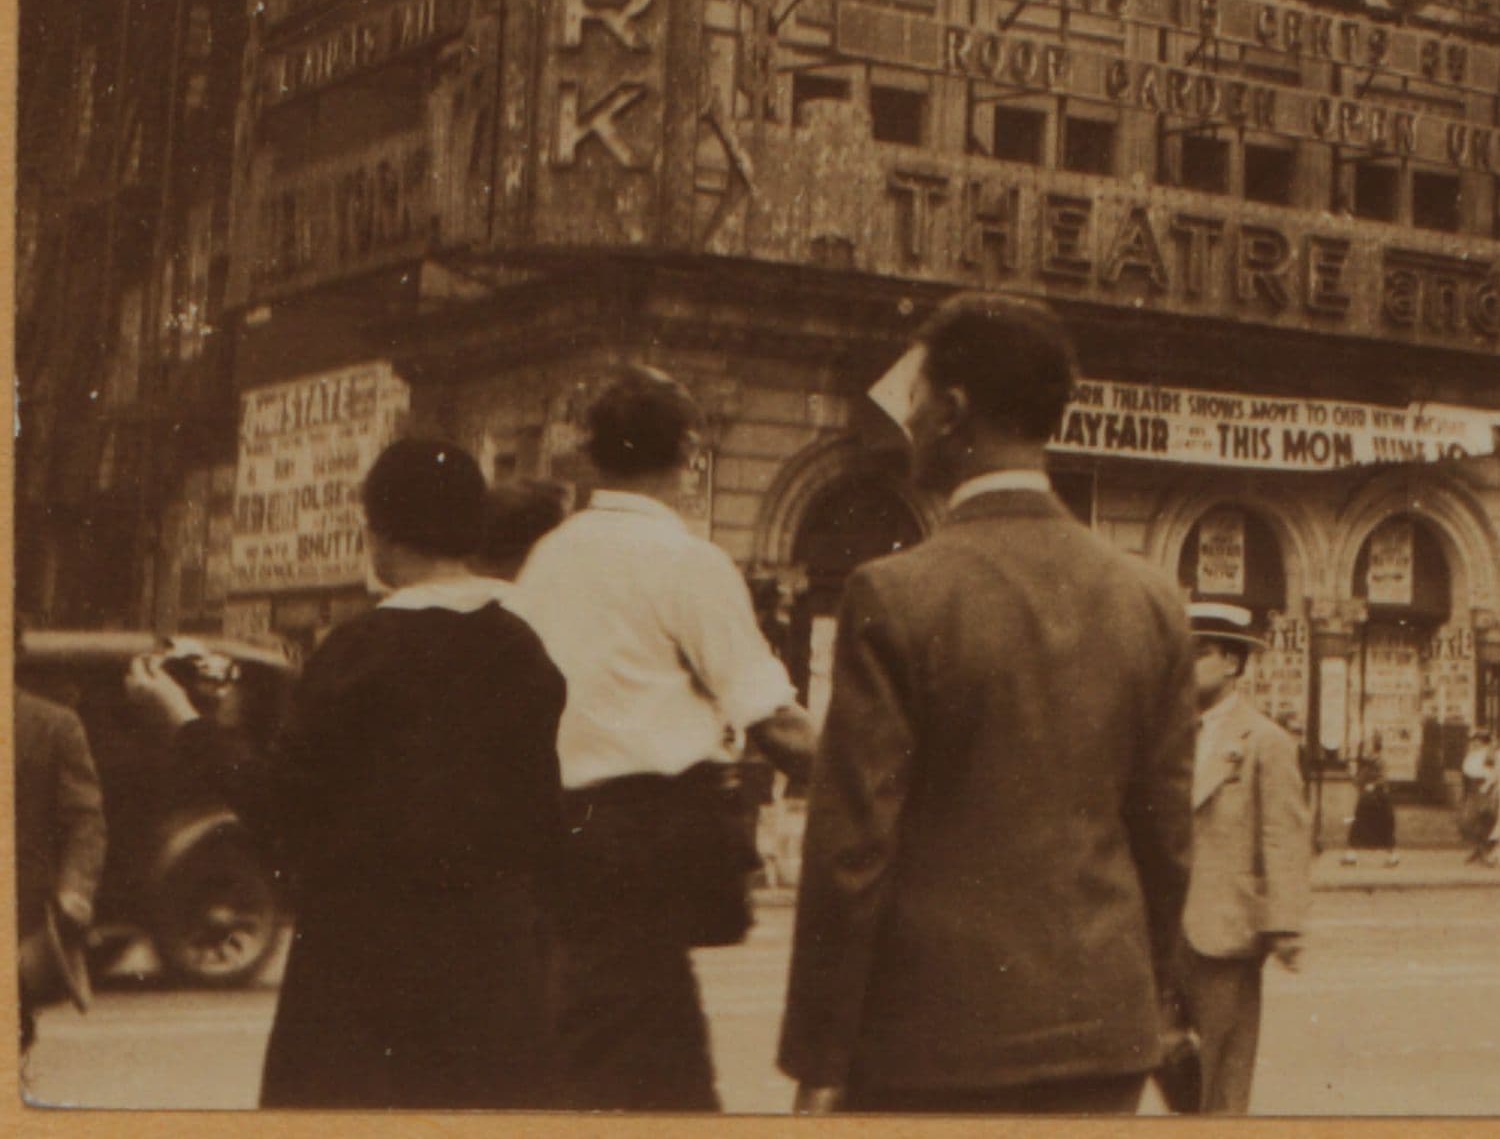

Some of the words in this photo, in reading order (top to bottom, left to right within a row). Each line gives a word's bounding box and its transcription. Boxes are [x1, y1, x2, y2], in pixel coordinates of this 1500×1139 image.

[888, 168, 1352, 321] THEATRE
[1113, 386, 1181, 413] THEATRE
[1187, 393, 1245, 420] SHOWS
[1250, 399, 1299, 423] MOVE
[1305, 403, 1328, 425] TO
[1055, 410, 1169, 453] AYFAIR
[1217, 421, 1272, 460] THIS
